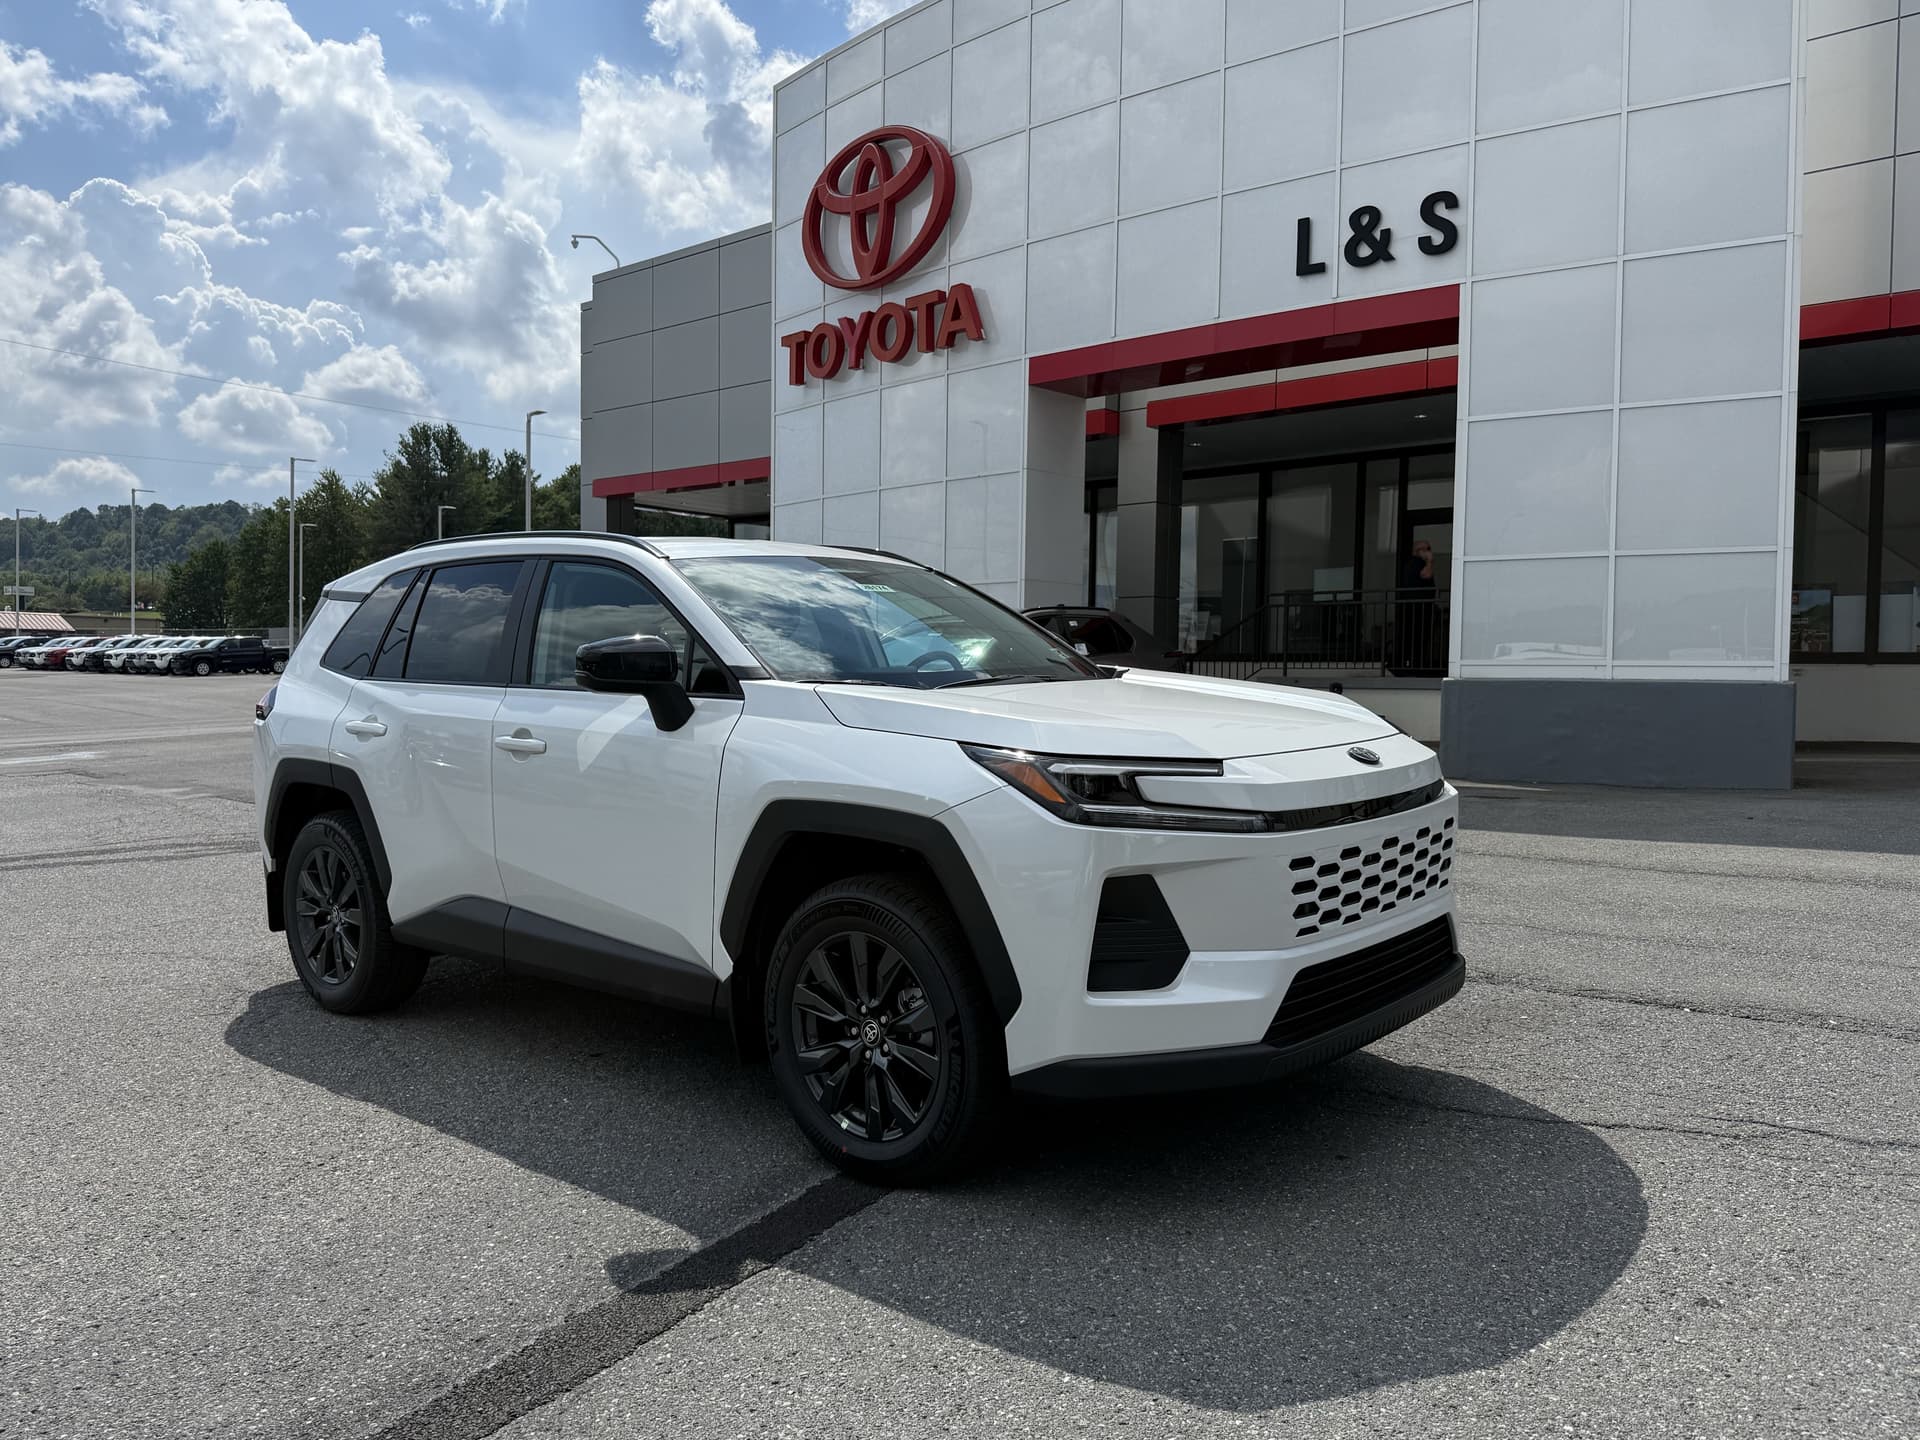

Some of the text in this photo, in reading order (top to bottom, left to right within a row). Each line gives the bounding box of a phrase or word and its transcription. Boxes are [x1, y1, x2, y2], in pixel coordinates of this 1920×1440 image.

[1296, 190, 1459, 276] L & S
[781, 282, 986, 386] TOYOTA
